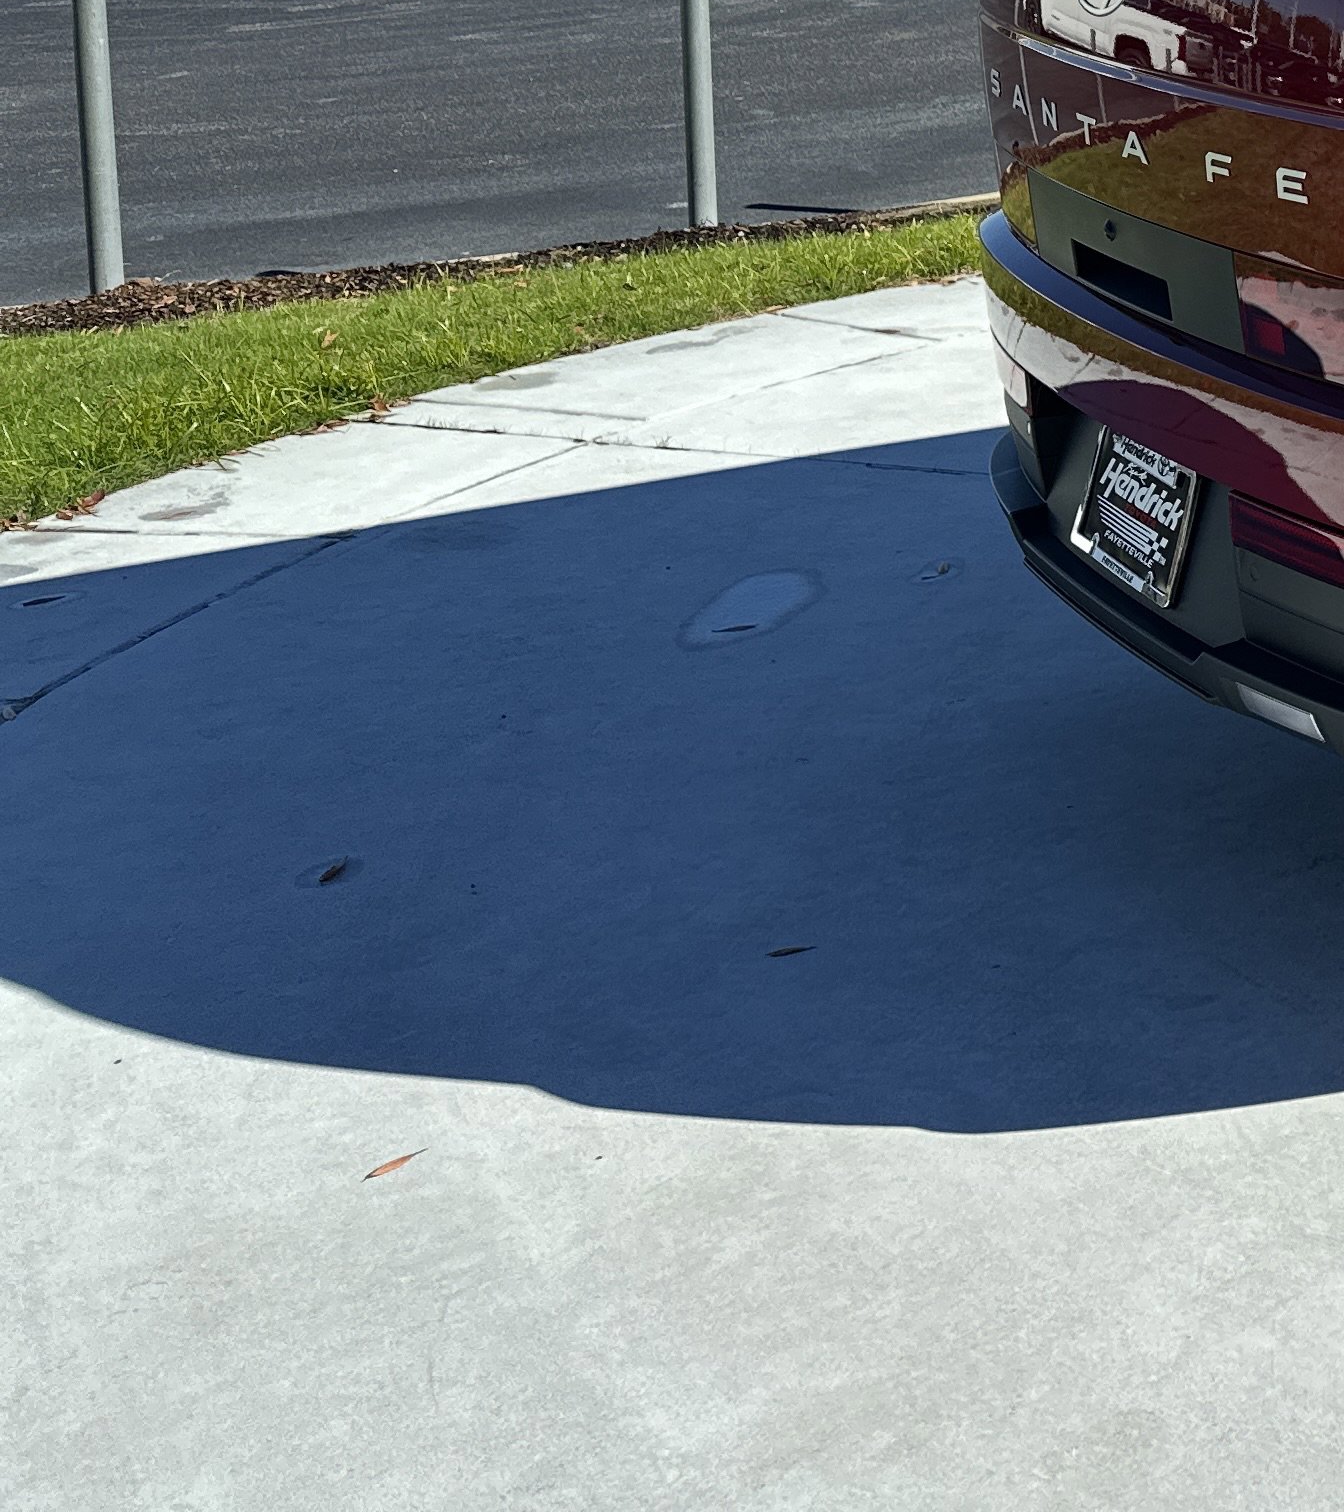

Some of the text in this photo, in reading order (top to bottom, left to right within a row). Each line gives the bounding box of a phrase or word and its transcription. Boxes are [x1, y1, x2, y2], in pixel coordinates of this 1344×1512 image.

[989, 68, 1309, 204] SANTA FE
[1099, 457, 1184, 531] Hendrick
[1104, 529, 1154, 568] FAYETTEVILLE
